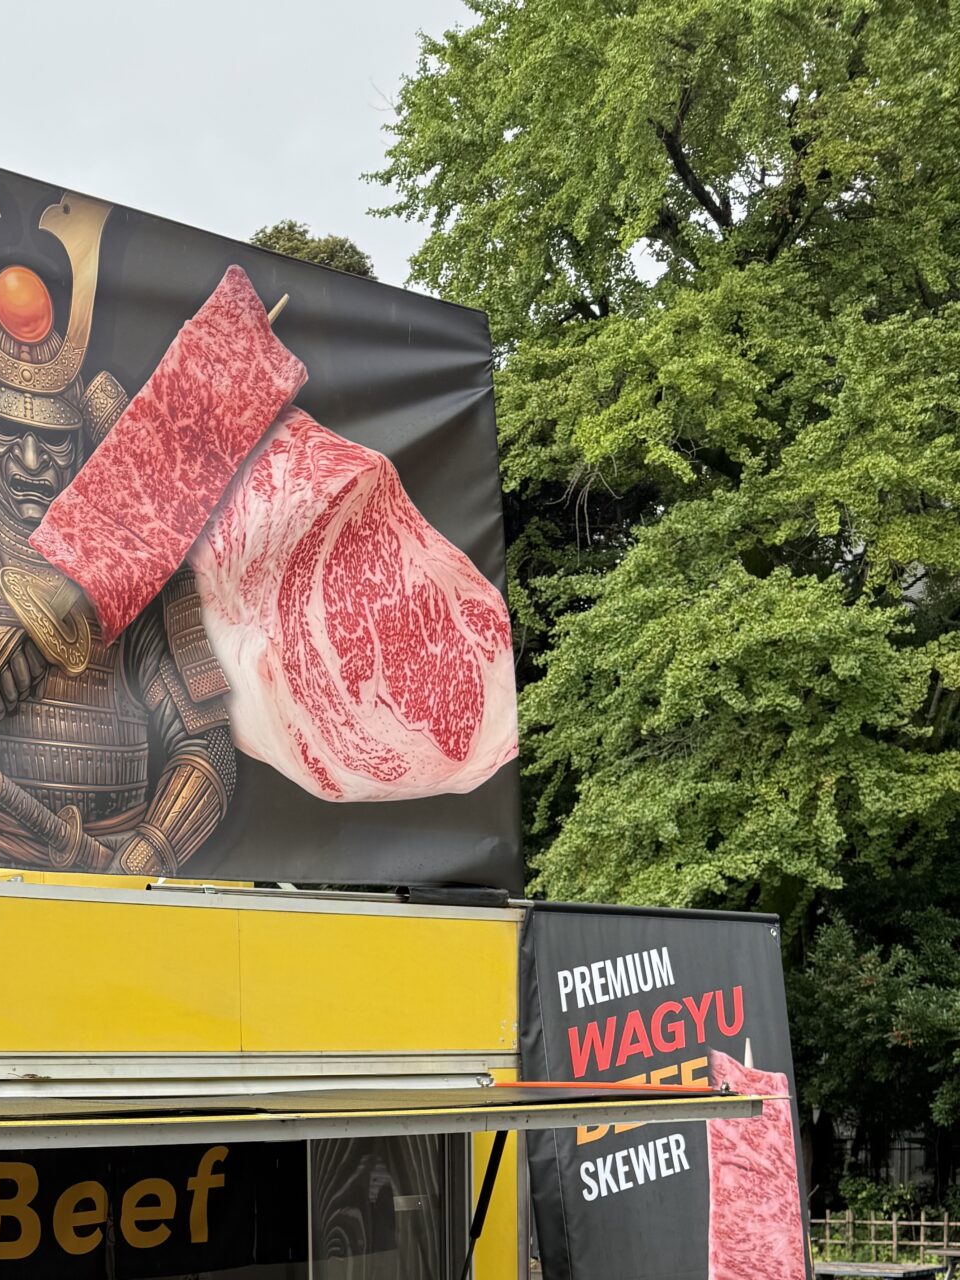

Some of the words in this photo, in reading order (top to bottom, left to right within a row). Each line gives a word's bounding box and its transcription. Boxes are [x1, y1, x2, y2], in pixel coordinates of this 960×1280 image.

[557, 947, 675, 1013] PREMIUM
[568, 985, 745, 1080] WAGYU
[579, 1133, 690, 1202] SKEWER
